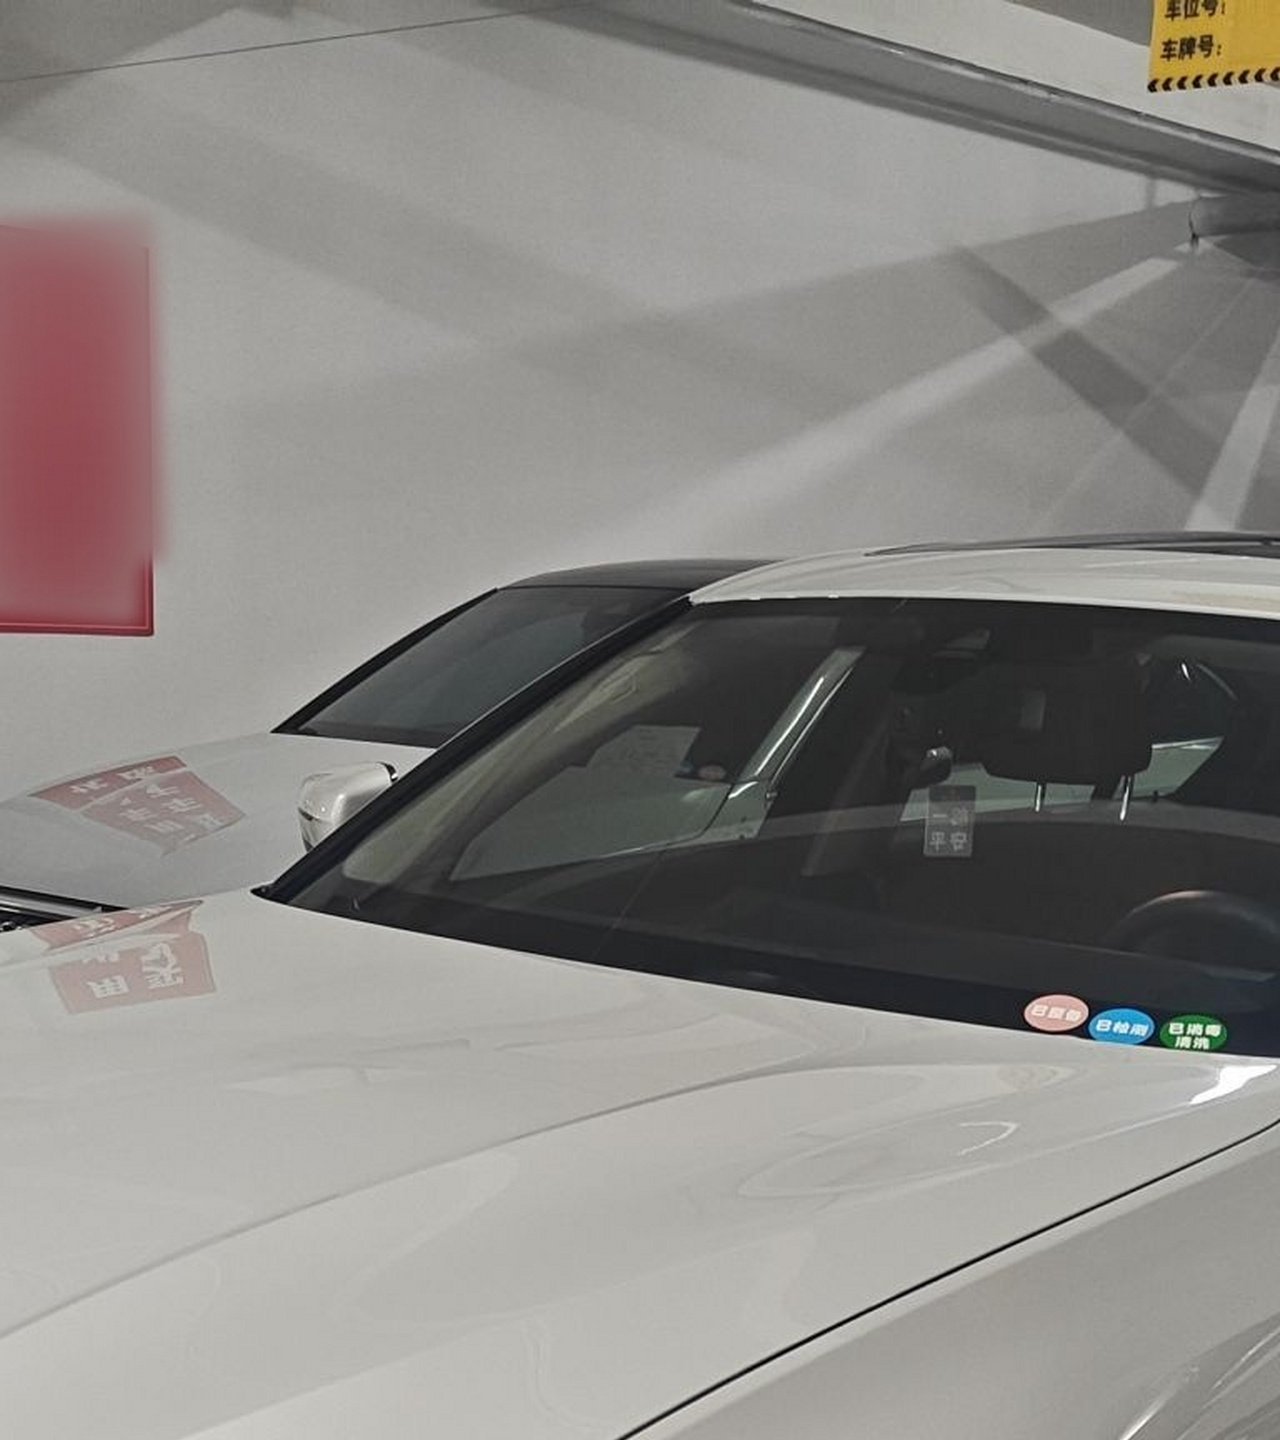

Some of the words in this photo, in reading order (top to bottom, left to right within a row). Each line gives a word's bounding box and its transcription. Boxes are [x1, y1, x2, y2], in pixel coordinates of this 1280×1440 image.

[1160, 34, 1222, 62] 车牌号：
[929, 831, 968, 853] 平安
[1096, 1019, 1148, 1037] 已检测
